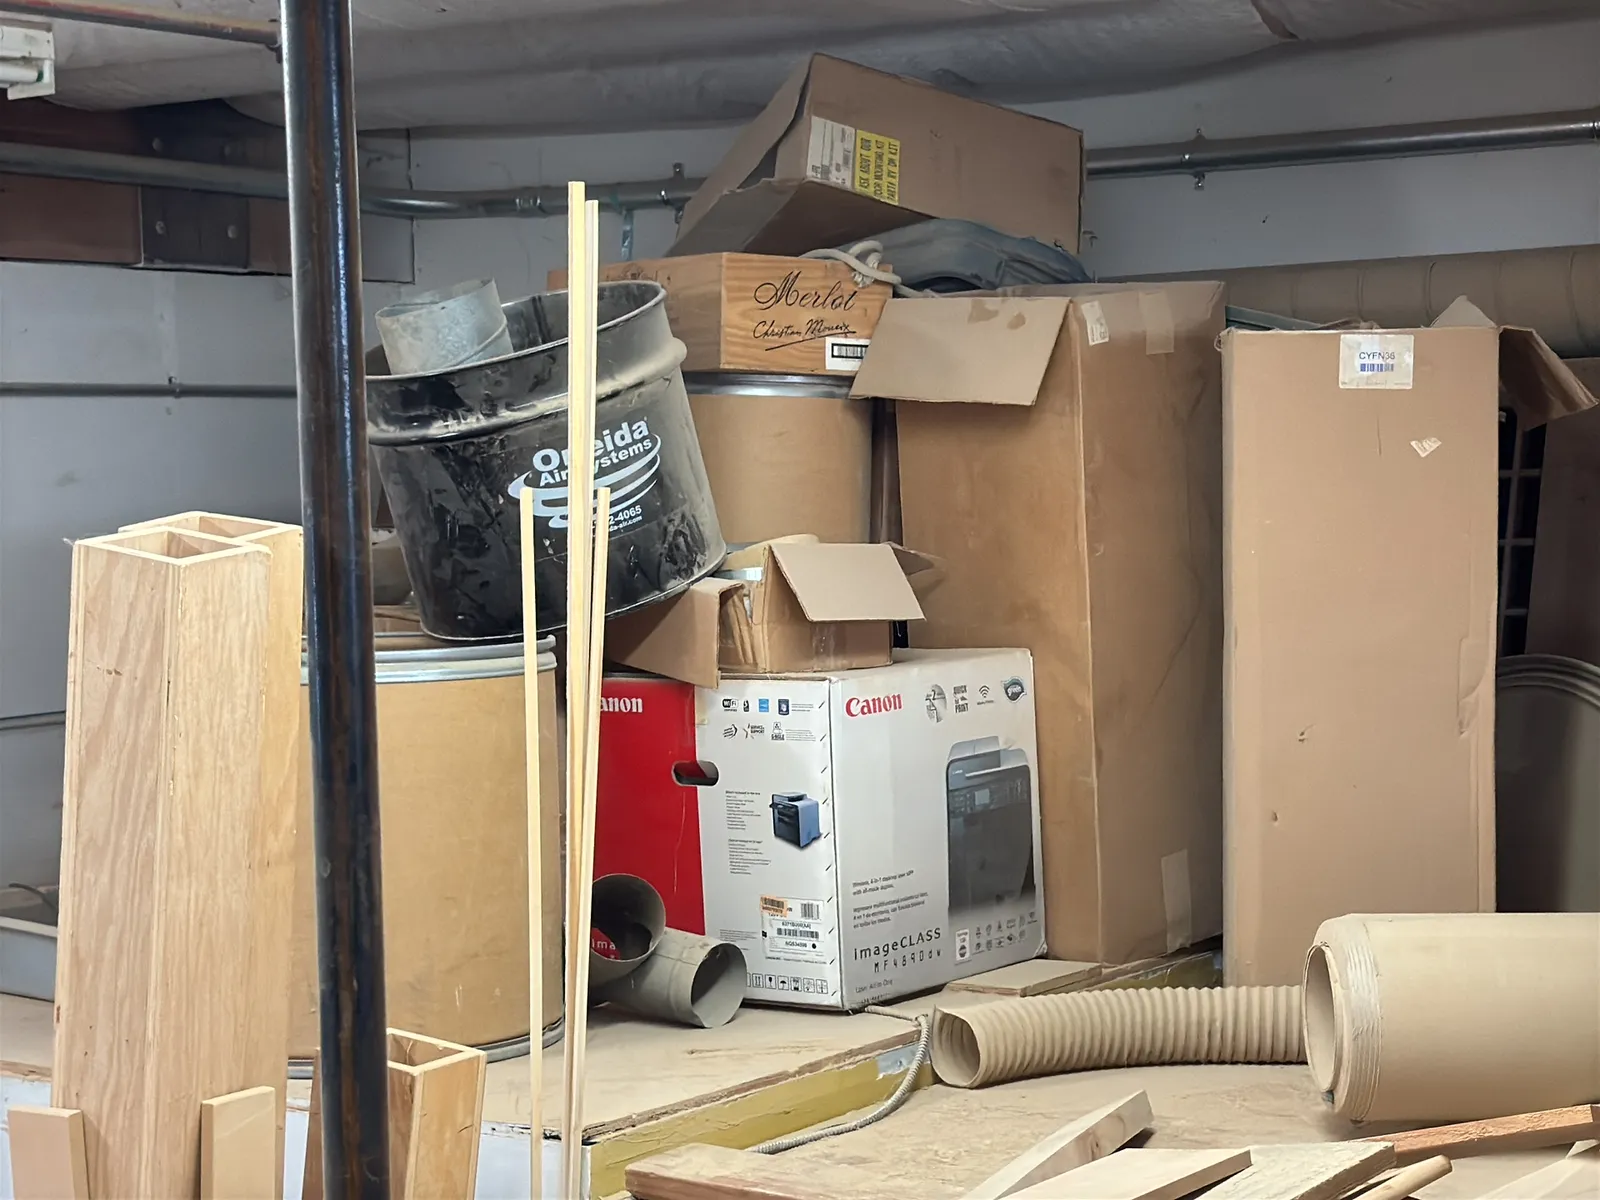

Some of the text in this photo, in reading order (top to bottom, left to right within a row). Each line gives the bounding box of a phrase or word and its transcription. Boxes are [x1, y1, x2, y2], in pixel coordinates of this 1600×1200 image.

[754, 271, 858, 311] Merlot
[594, 438, 653, 474] ystems
[600, 698, 644, 713] anon
[845, 693, 903, 718] Canon
[854, 927, 941, 961] imageCLASS
